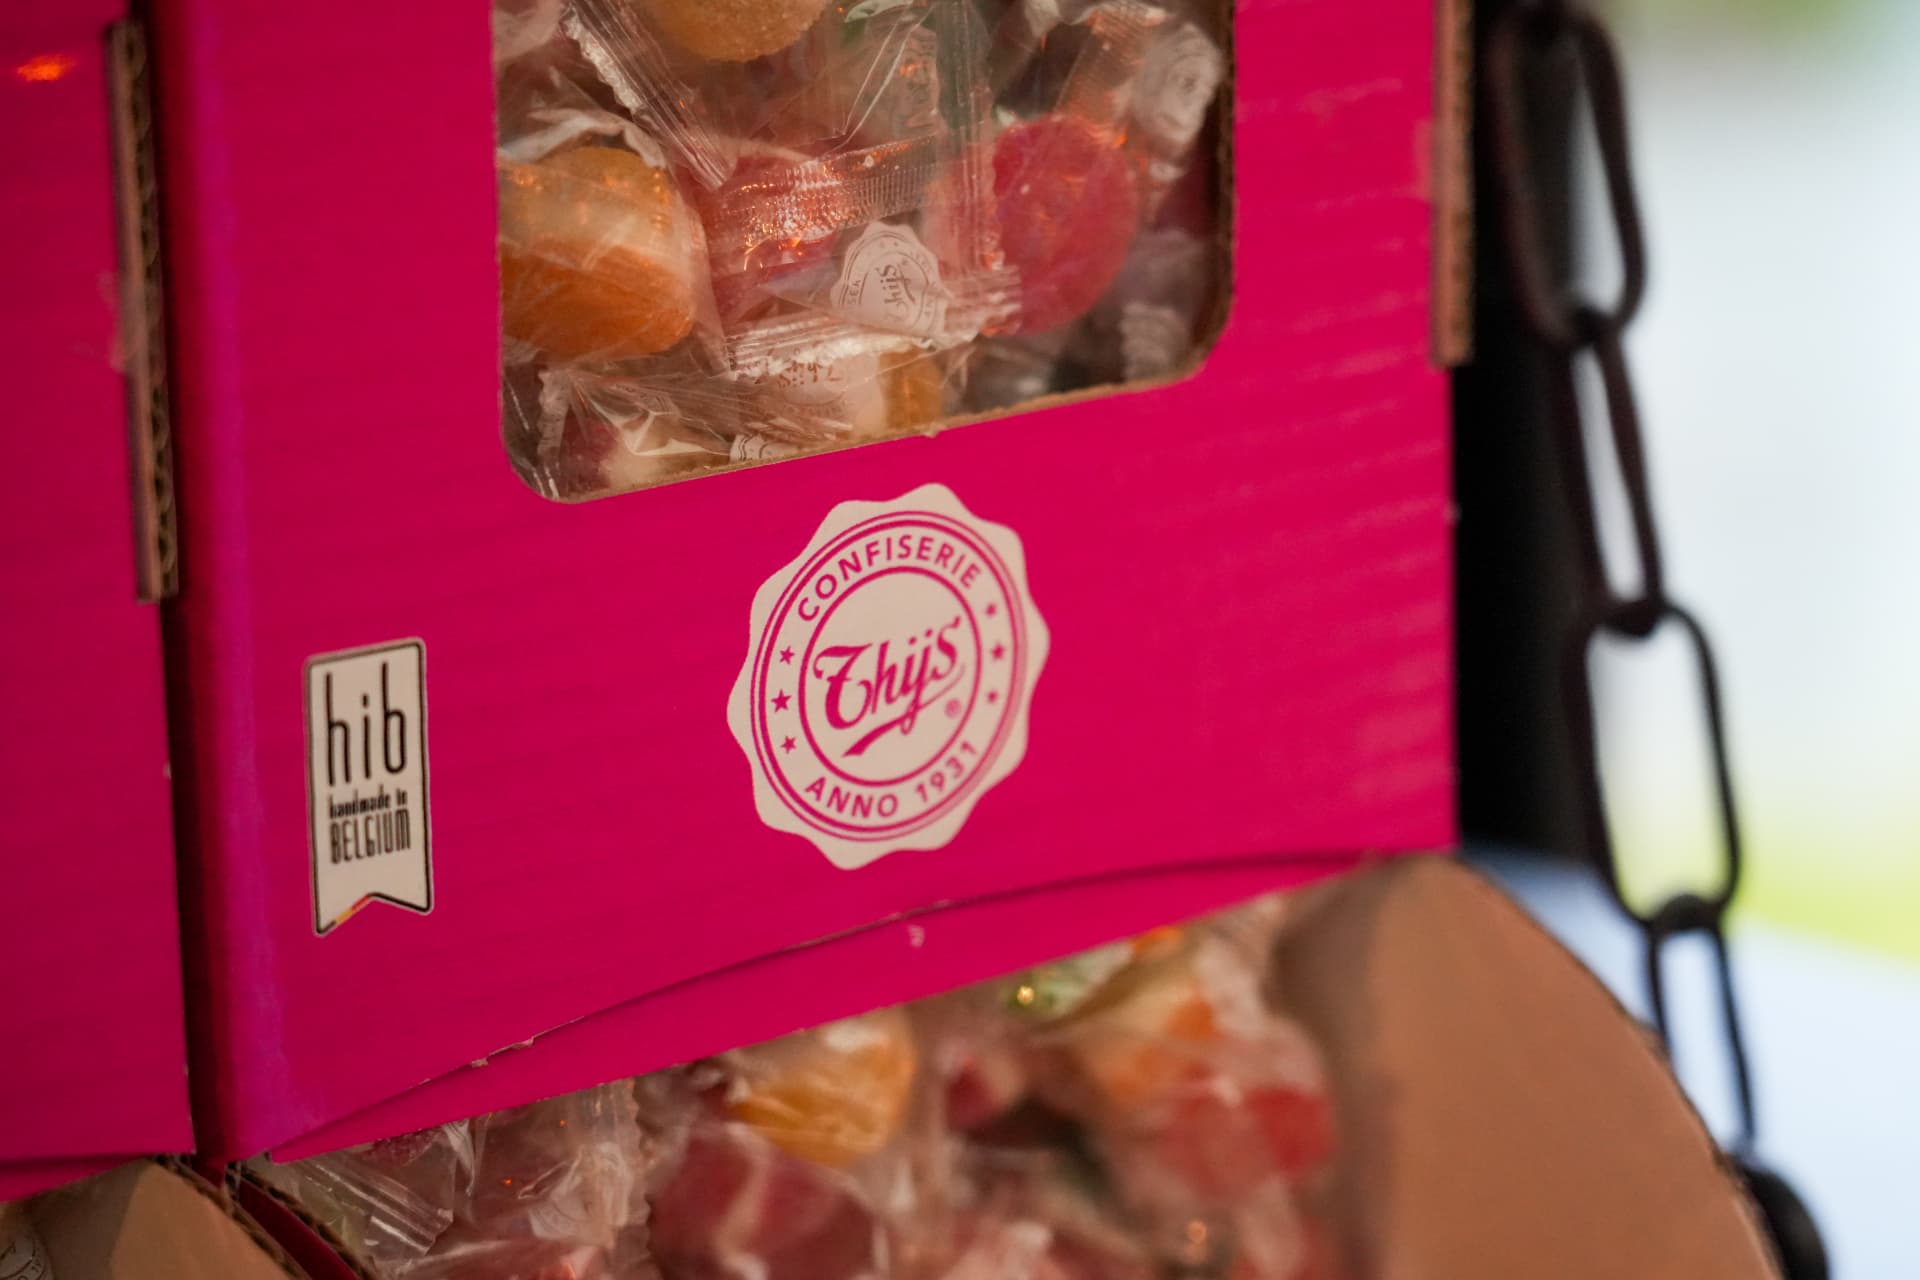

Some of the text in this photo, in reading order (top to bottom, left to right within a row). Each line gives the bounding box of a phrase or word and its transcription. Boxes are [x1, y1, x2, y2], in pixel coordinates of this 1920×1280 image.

[798, 534, 982, 621] CONFISERIE
[325, 661, 407, 786] hib
[328, 784, 408, 819] handmade in
[805, 740, 979, 819] ANNO 1931
[330, 808, 410, 863] BELGIUM
